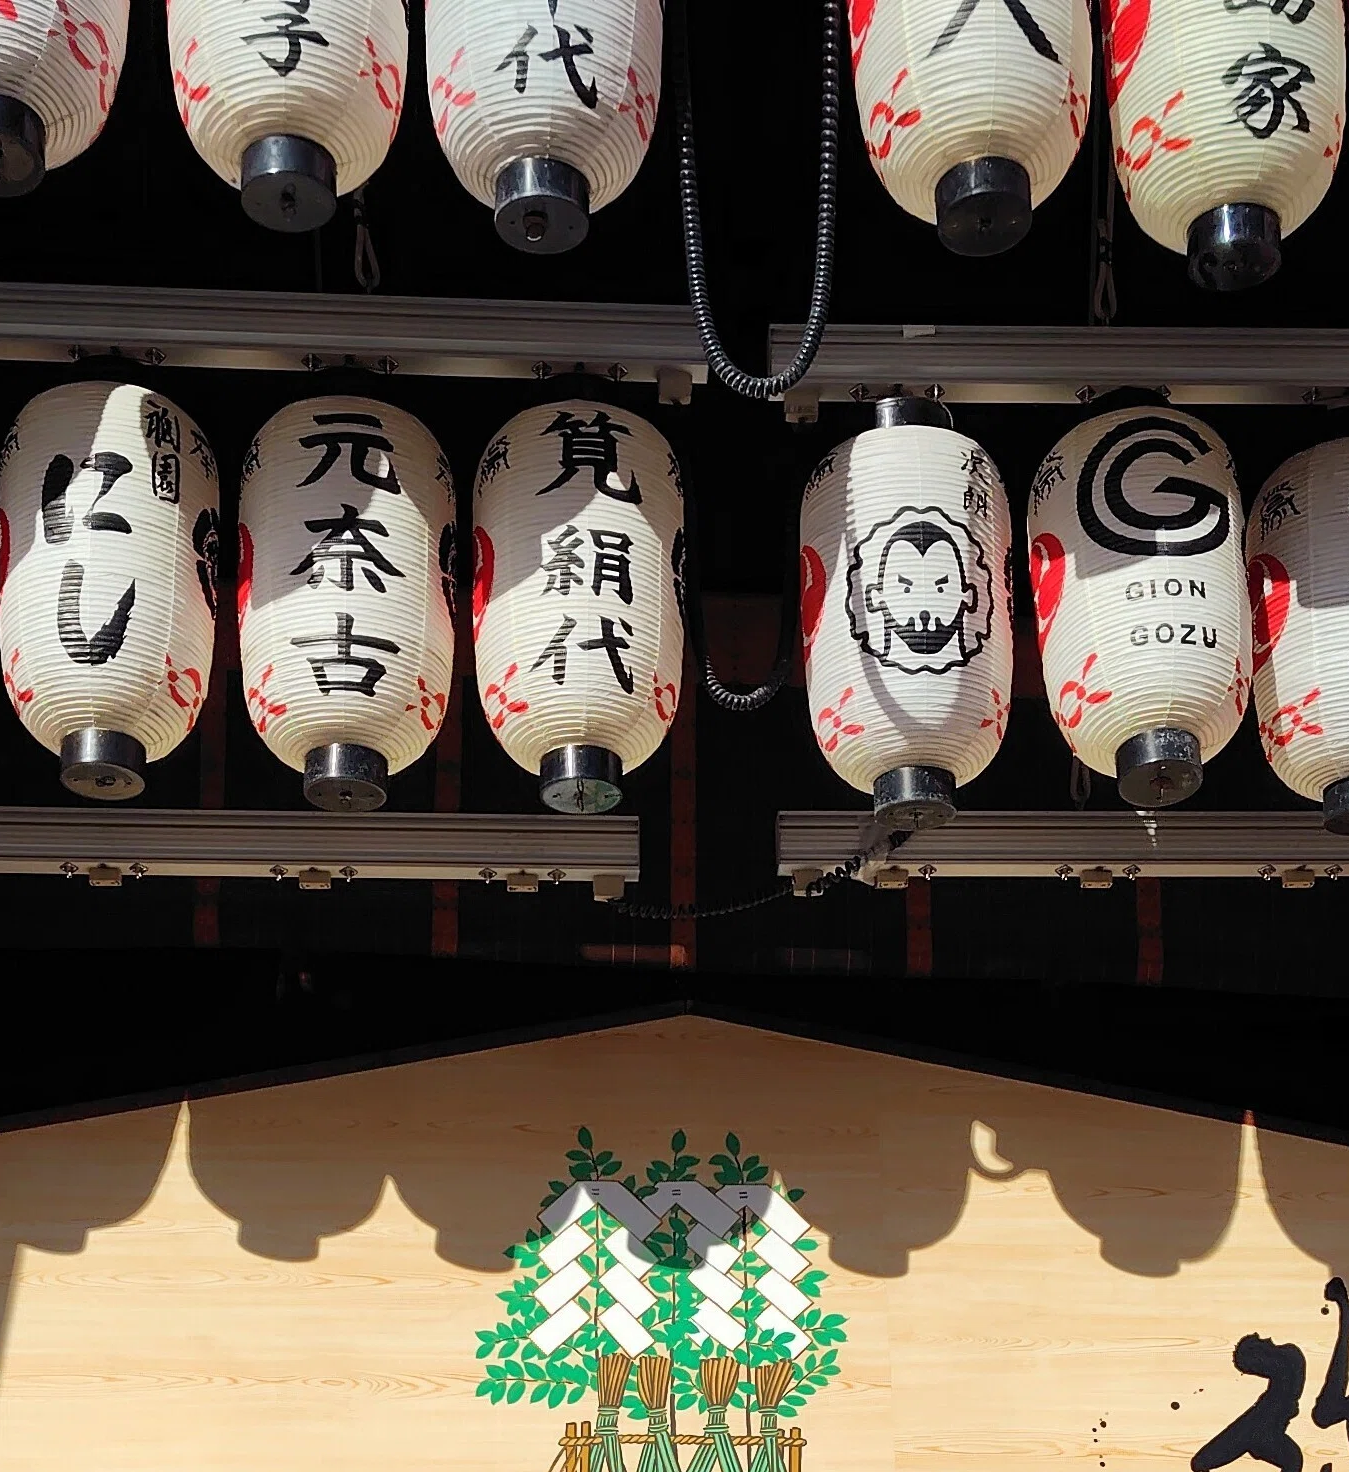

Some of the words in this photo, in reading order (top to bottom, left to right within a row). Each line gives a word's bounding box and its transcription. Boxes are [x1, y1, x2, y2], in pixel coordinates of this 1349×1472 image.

[241, 0, 329, 77] 子
[495, 0, 601, 110] 代
[1223, 0, 1318, 139] 家
[41, 452, 136, 667] にし
[289, 413, 407, 698] 元奈古
[1124, 576, 1207, 602] GION
[1129, 622, 1219, 649] GOZU
